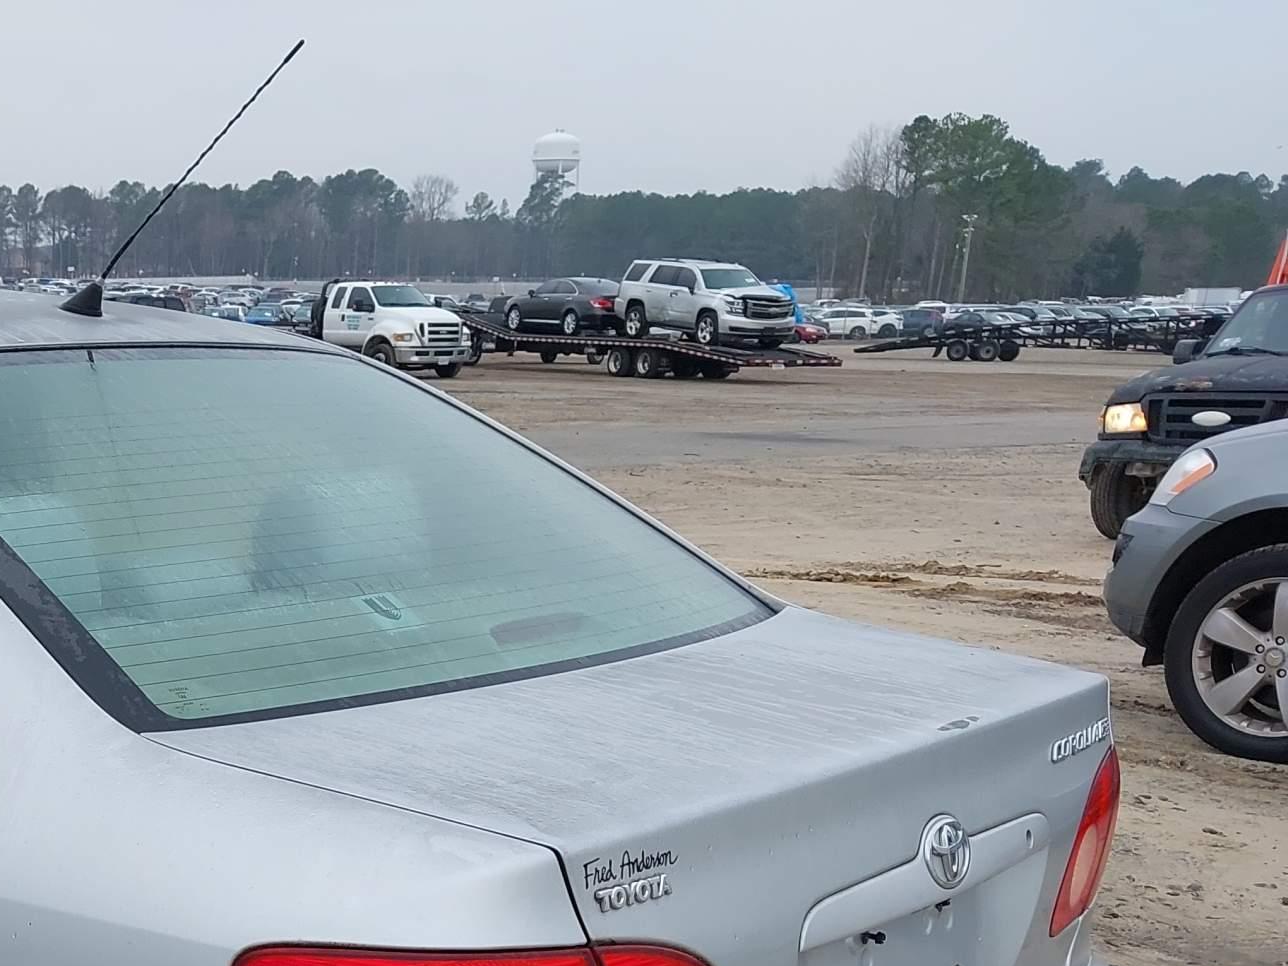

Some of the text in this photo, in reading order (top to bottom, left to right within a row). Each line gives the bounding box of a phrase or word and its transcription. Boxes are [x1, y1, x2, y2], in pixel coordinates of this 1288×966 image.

[583, 849, 679, 890] Fred Anderson
[594, 874, 672, 913] TOYOTA
